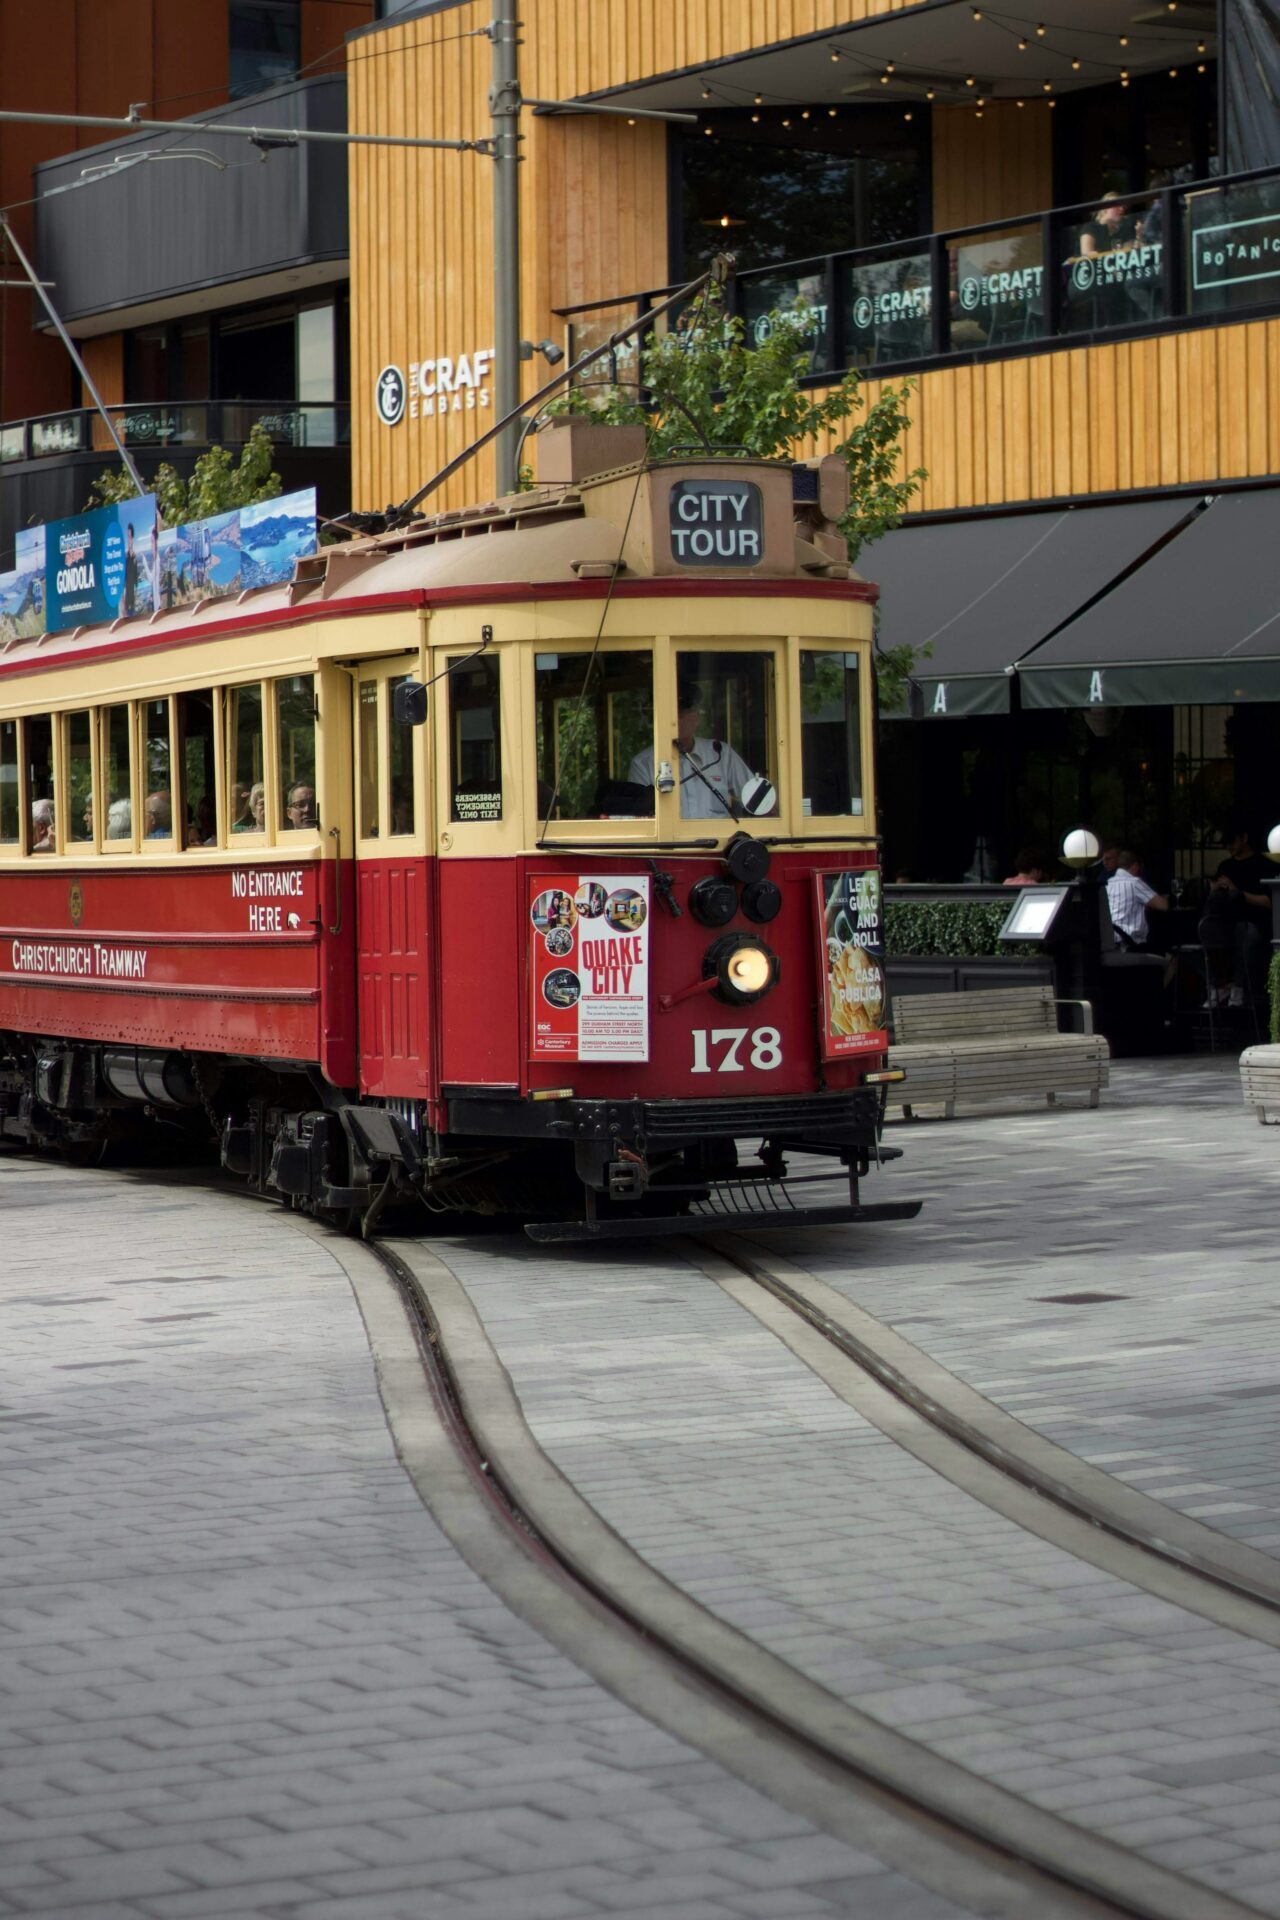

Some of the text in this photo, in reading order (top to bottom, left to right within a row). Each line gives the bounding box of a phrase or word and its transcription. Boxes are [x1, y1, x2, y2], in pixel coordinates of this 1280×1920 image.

[1103, 243, 1163, 273] CRAFT
[988, 265, 1044, 293] CRAFT
[1096, 264, 1162, 286] EMBASSY
[880, 286, 932, 313] CRAFT
[981, 287, 1042, 306] EMBASSY
[874, 303, 930, 324] EMBASSY
[409, 386, 495, 419] EMBASS
[678, 494, 749, 522] CITY
[671, 529, 759, 556] TOUR
[56, 563, 95, 595] GONDOLA
[933, 683, 947, 713] A
[1089, 671, 1103, 702] A
[231, 870, 303, 898] NO ENTRANCE
[849, 877, 876, 893] LET'S
[849, 895, 878, 911] GUAC
[249, 904, 282, 931] HERE
[857, 913, 879, 929] AND
[854, 931, 880, 947] ROLL
[12, 939, 147, 978] CHRISTCHURCH TRAMWAY
[582, 936, 643, 972] QUAKE
[592, 965, 633, 995] CITY
[855, 966, 881, 983] CASA
[690, 1026, 783, 1073] 178
